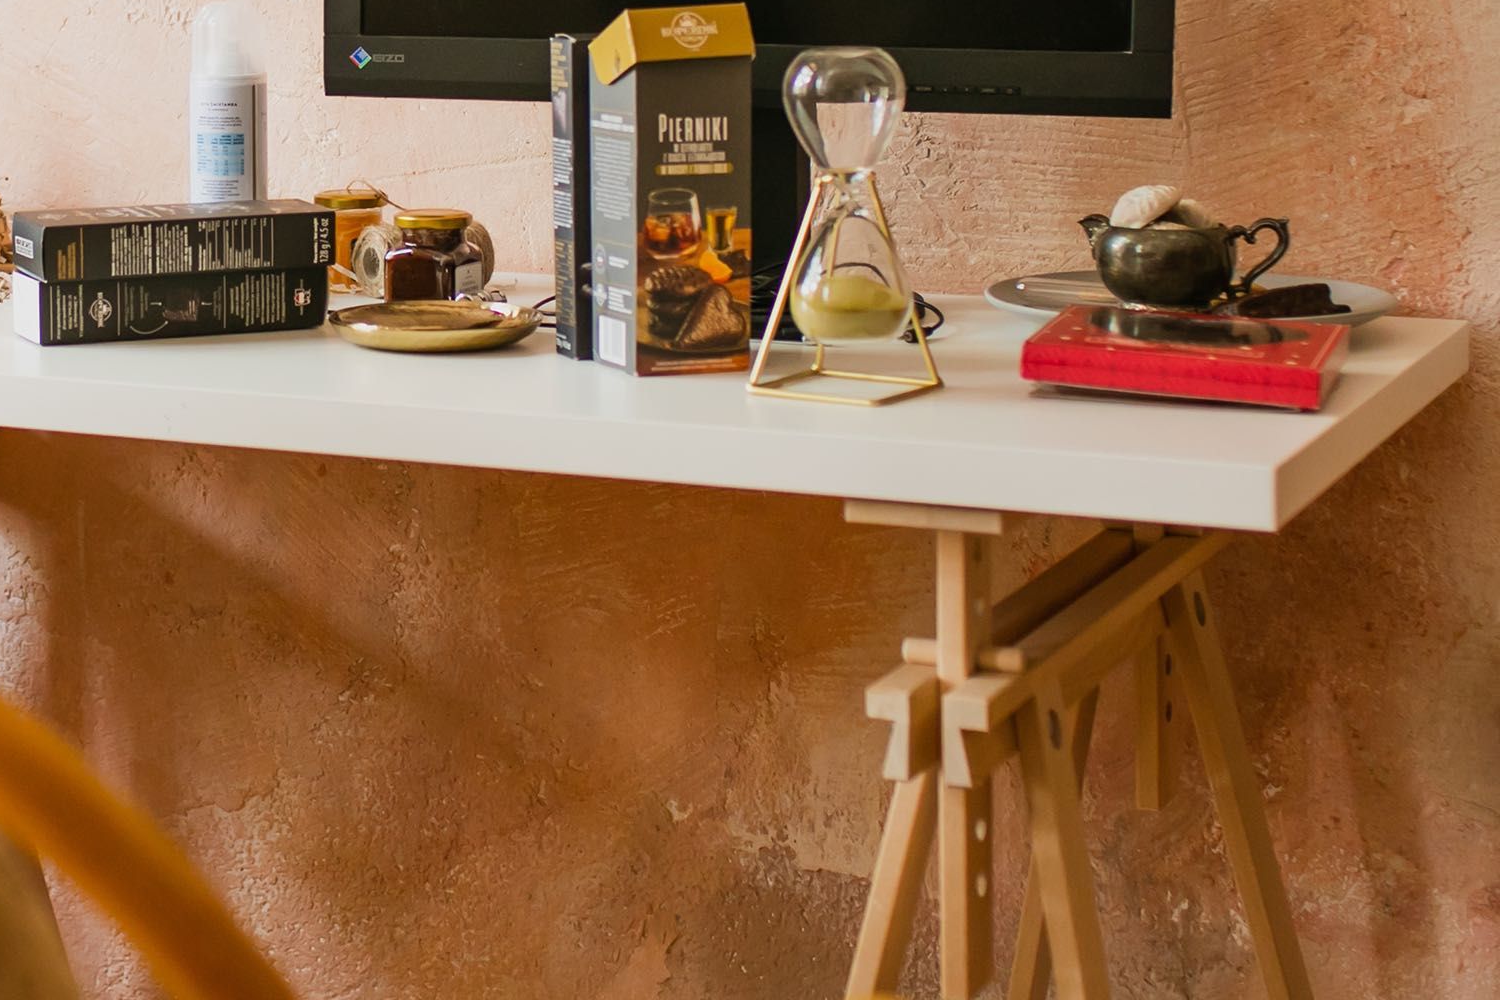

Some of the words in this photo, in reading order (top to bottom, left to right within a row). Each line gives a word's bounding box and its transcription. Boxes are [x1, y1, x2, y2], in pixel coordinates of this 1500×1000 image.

[658, 113, 729, 143] PIERNIKI
[320, 217, 329, 227] oz
[319, 227, 329, 239] 4.5
[319, 249, 329, 263] 128
